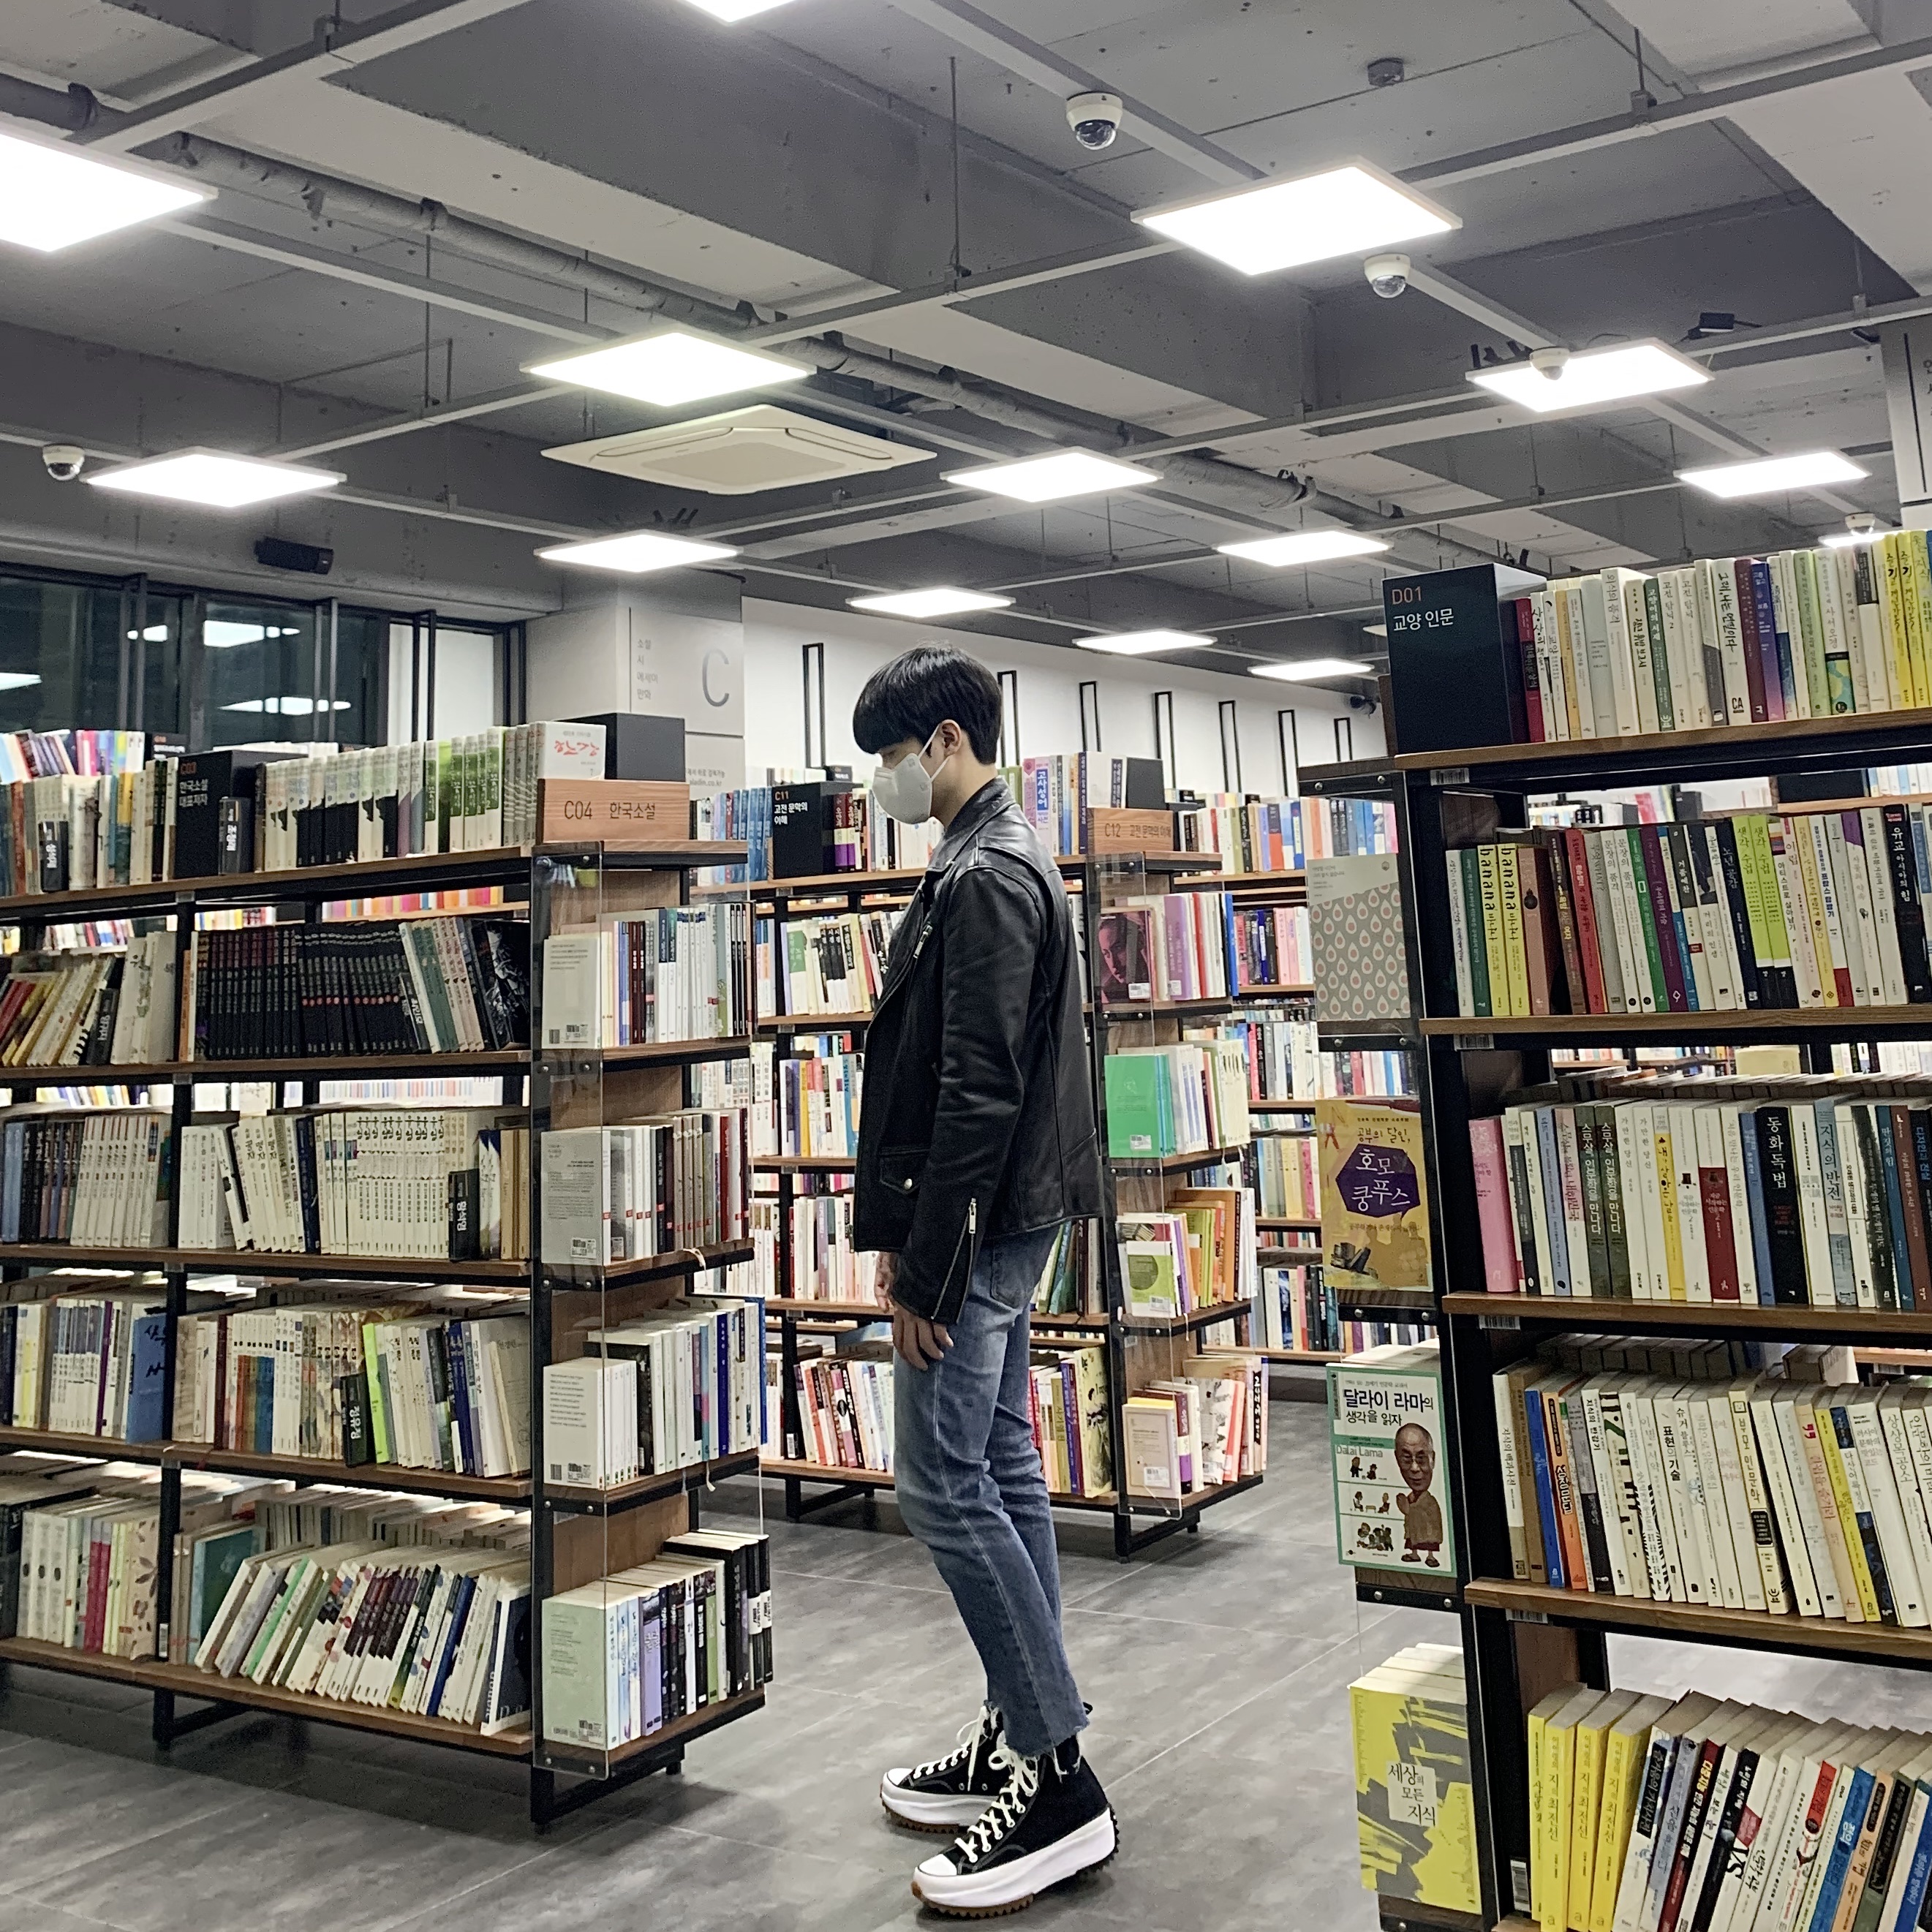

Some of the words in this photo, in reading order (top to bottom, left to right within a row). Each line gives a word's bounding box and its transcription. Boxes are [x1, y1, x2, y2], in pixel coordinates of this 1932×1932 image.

[1391, 586, 1423, 605] D01
[1393, 612, 1422, 632] 교양
[1425, 608, 1454, 628] 인문
[637, 638, 652, 650] 소설
[637, 672, 658, 684] 에세이
[702, 649, 729, 707] C
[774, 790, 789, 800] C11
[1037, 770, 1049, 810] 고사성어
[564, 800, 592, 820] C04
[609, 801, 656, 820] 한국소설
[788, 802, 808, 813] 문학의
[774, 815, 788, 825] 이해
[1105, 823, 1121, 838] C12
[1737, 827, 1749, 847] 생각
[1755, 826, 1766, 847] 생각
[1741, 853, 1754, 875] 수업
[1759, 853, 1770, 875] 수업
[1480, 848, 1496, 911] banana
[1501, 847, 1517, 911] banana
[1778, 861, 1790, 899] 아티스트로
[1785, 902, 1796, 931] 살아남기
[1487, 913, 1498, 941] 바나나
[1507, 913, 1519, 941] 바나나
[1357, 1128, 1384, 1143] 공부의
[1386, 1127, 1411, 1144] 달인,
[1819, 1124, 1837, 1169] 지식의
[1917, 1127, 1928, 1161] 디자인과
[1356, 1148, 1395, 1175] 호모
[1920, 1163, 1931, 1181] 진실
[1585, 1159, 1599, 1201] 인문학을
[1604, 1158, 1618, 1201] 인문학을
[1826, 1170, 1842, 1201] 반전
[1351, 1179, 1411, 1212] 쿵푸스
[458, 1201, 467, 1231] 황석영
[1590, 1203, 1602, 1235] 만나다
[1610, 1203, 1622, 1234] 만나다
[1343, 1389, 1389, 1411] 달라이
[1394, 1392, 1434, 1413] 라마의
[1586, 1399, 1596, 1423] 지식의
[350, 1405, 361, 1440] 정유정
[1346, 1410, 1378, 1424] 생각을
[1381, 1413, 1403, 1426] 읽자
[1675, 1408, 1687, 1428] 슈거
[1502, 1427, 1512, 1451] 지식의
[1590, 1427, 1601, 1452] 반감기
[1663, 1425, 1677, 1457] 표현의
[1857, 1427, 1878, 1436] 러시아
[1858, 1437, 1881, 1447] 문학의
[1912, 1414, 1931, 1469] 인문학의
[1336, 1445, 1358, 1456] Dalai
[1359, 1446, 1384, 1458] Lama
[1886, 1414, 1914, 1483] 상상목공소
[1504, 1453, 1517, 1486] 백과사전
[1669, 1460, 1681, 1482] 기술
[1743, 1454, 1762, 1503] 인문학
[1389, 1764, 1425, 1786] 세상의
[1697, 1759, 1713, 1792] 다중지능
[1402, 1787, 1425, 1803] 모든
[1710, 1797, 1721, 1814] 보는
[1408, 1804, 1435, 1827] 지식
[1639, 1790, 1656, 1833] 가치사전
[1727, 1846, 1749, 1879] VS
